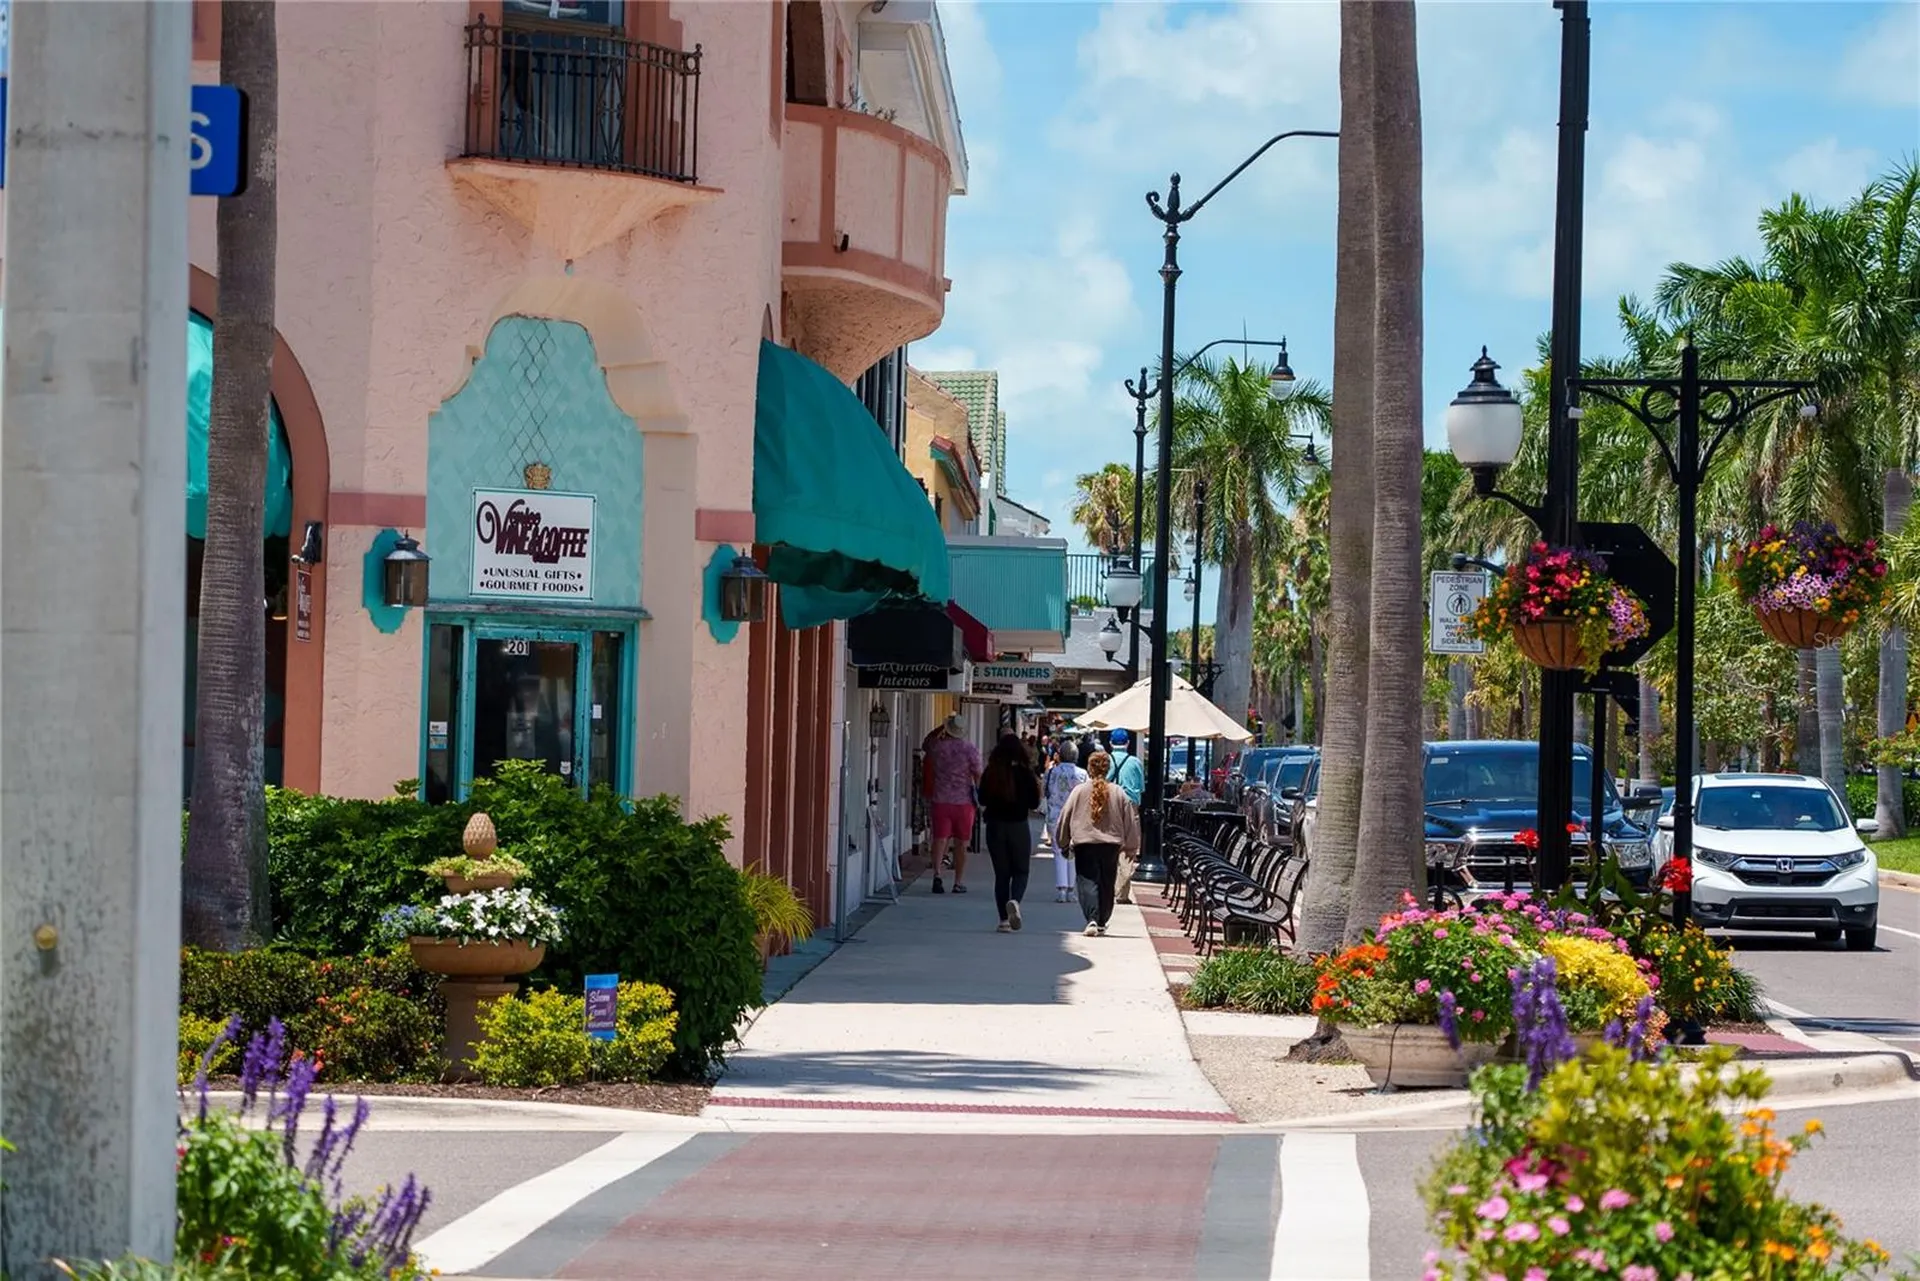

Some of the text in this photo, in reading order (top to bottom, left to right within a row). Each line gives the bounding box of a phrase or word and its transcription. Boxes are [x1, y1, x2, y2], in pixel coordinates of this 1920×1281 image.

[489, 567, 576, 580] UNUSUAL GIFTS
[1436, 576, 1483, 584] PEDESTRIAN
[485, 580, 579, 593] GOURMET FOODS
[508, 641, 529, 655] 201
[983, 666, 1050, 679] STATIONERS
[878, 674, 931, 686] Interiors
